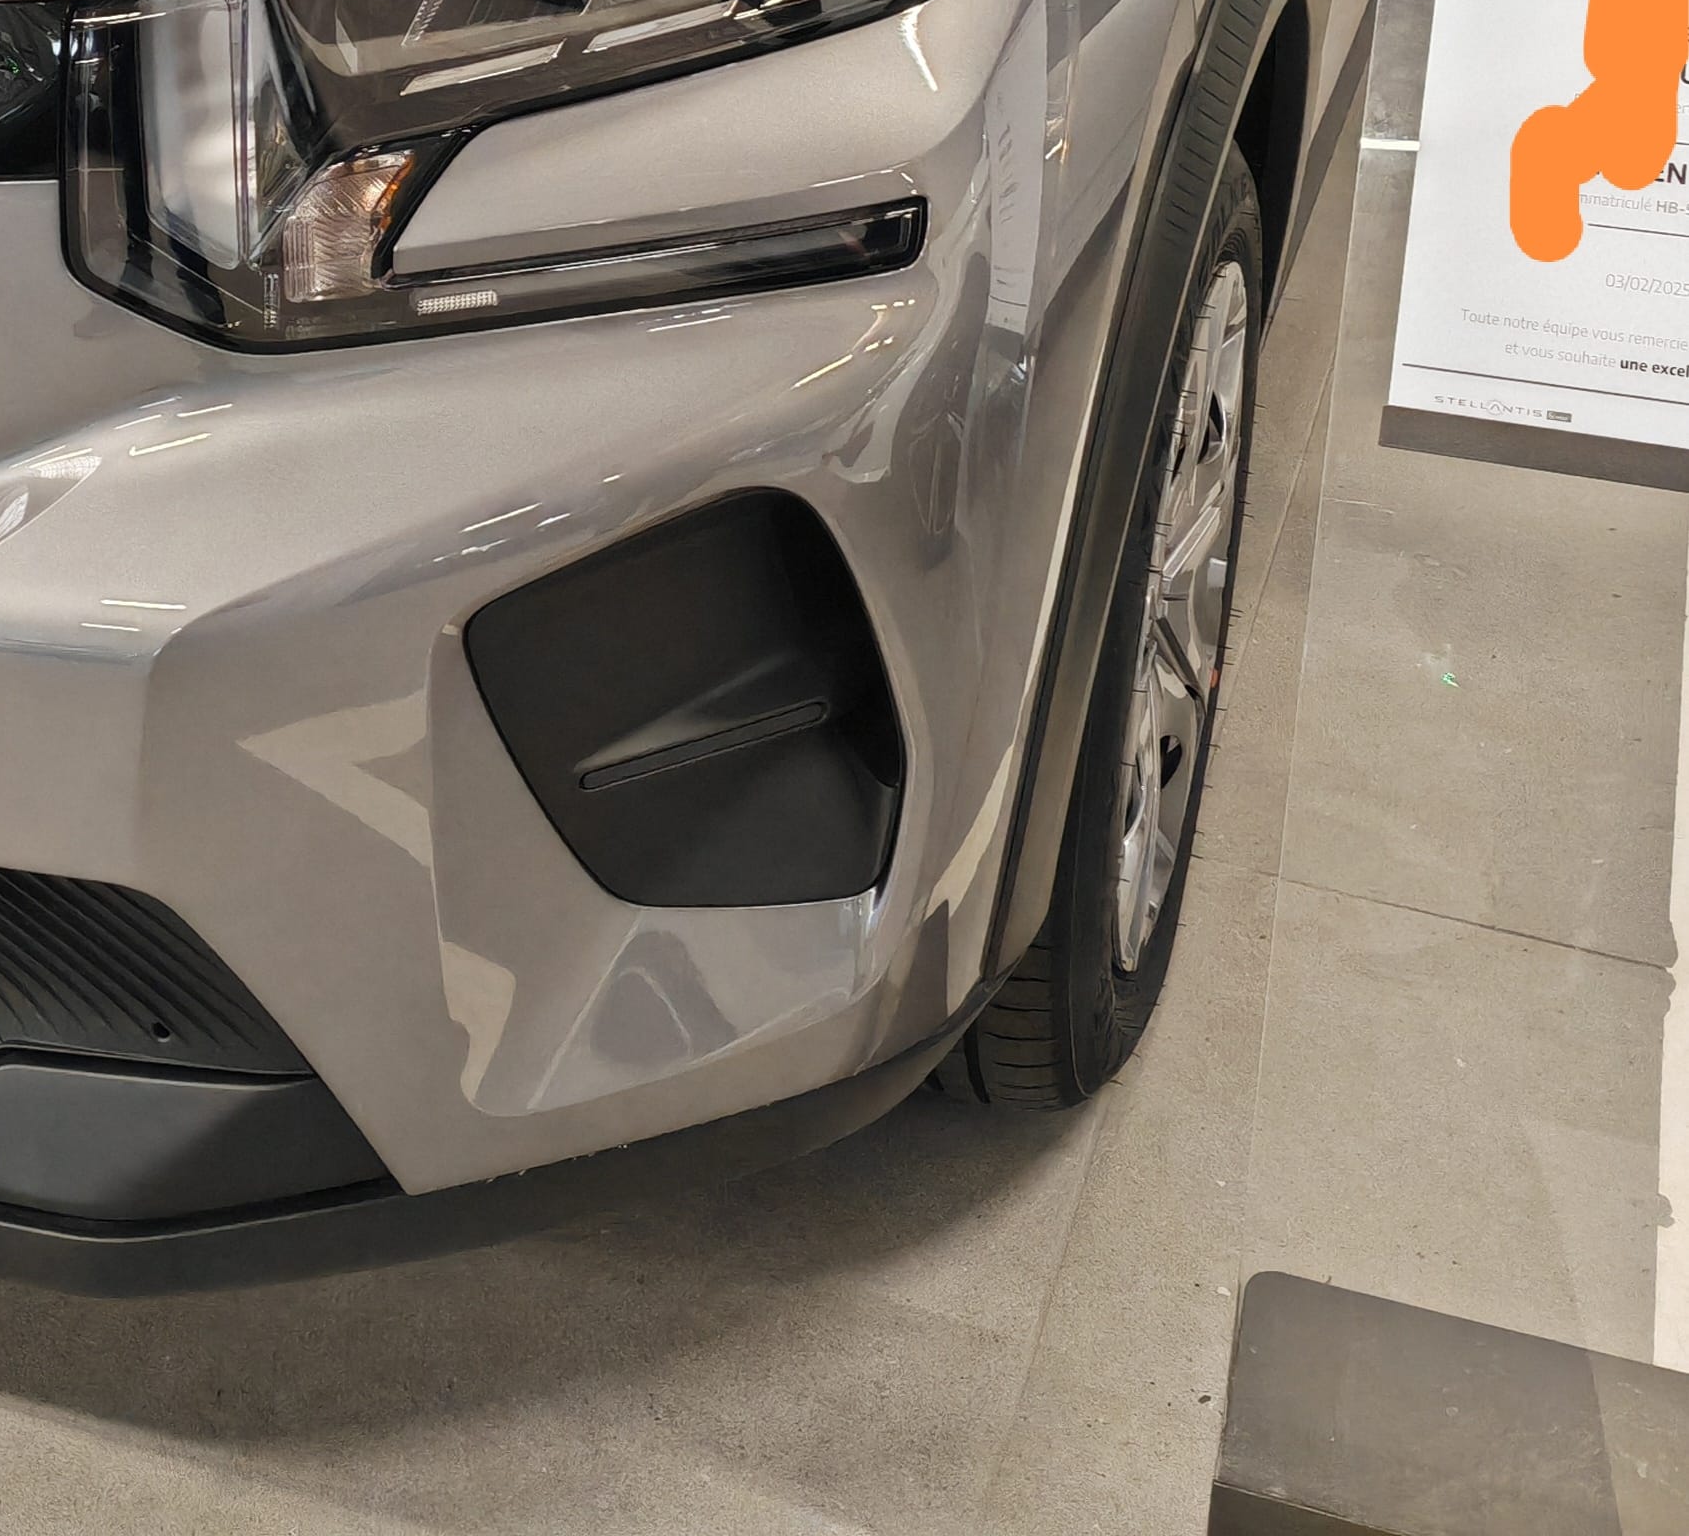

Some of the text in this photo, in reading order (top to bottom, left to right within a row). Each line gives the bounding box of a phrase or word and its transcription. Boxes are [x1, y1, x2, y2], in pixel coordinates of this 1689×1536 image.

[1605, 273, 1689, 297] 03/02/2025
[1461, 308, 1689, 351] Toute notre équipe vous remercie
[1505, 342, 1519, 356] et
[1521, 345, 1554, 359] vous
[1557, 350, 1616, 368] souhaite
[1620, 359, 1648, 372] une
[1433, 394, 1543, 418] STELLANTIS
